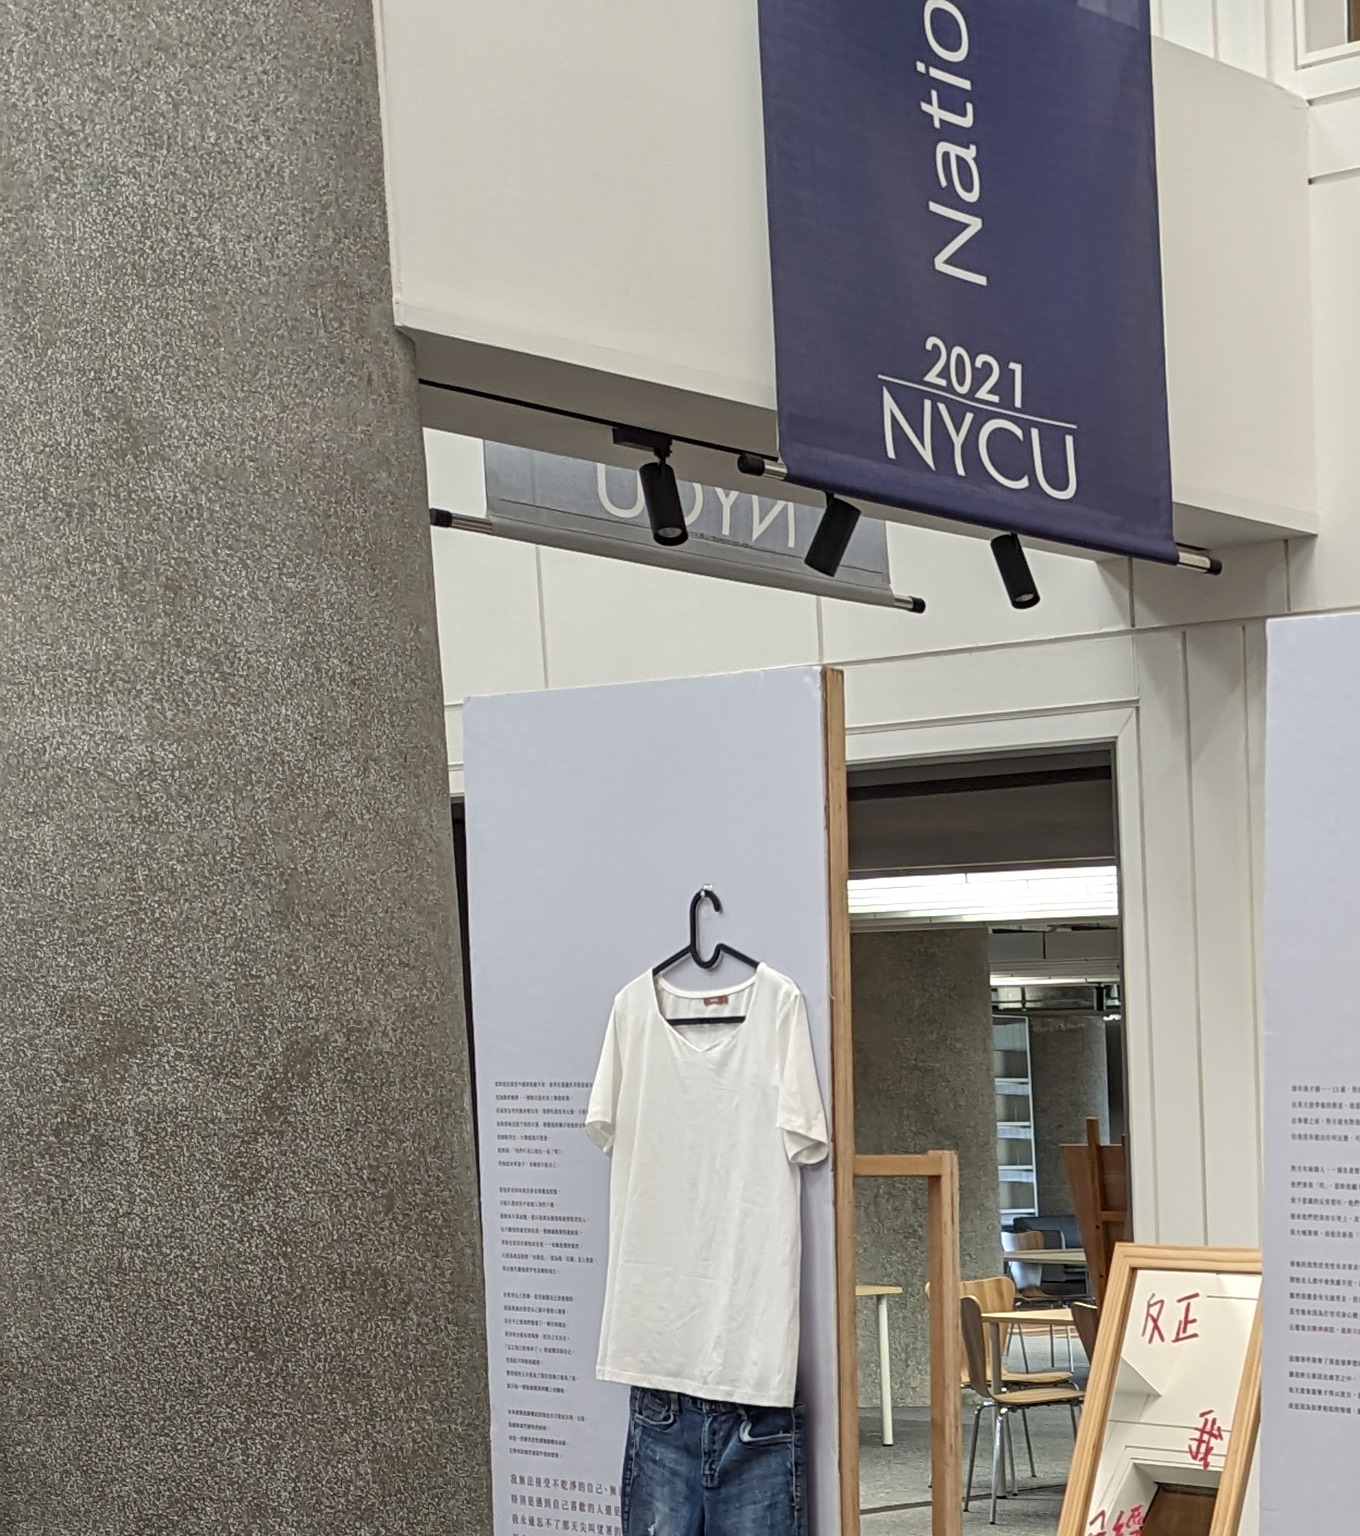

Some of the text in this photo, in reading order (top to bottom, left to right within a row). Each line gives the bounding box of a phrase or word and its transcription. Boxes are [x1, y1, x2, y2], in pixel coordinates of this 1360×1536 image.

[916, 0, 987, 286] Natio
[923, 336, 1022, 408] 2021
[882, 385, 1078, 500] NYCU
[1141, 1291, 1200, 1344] 反正
